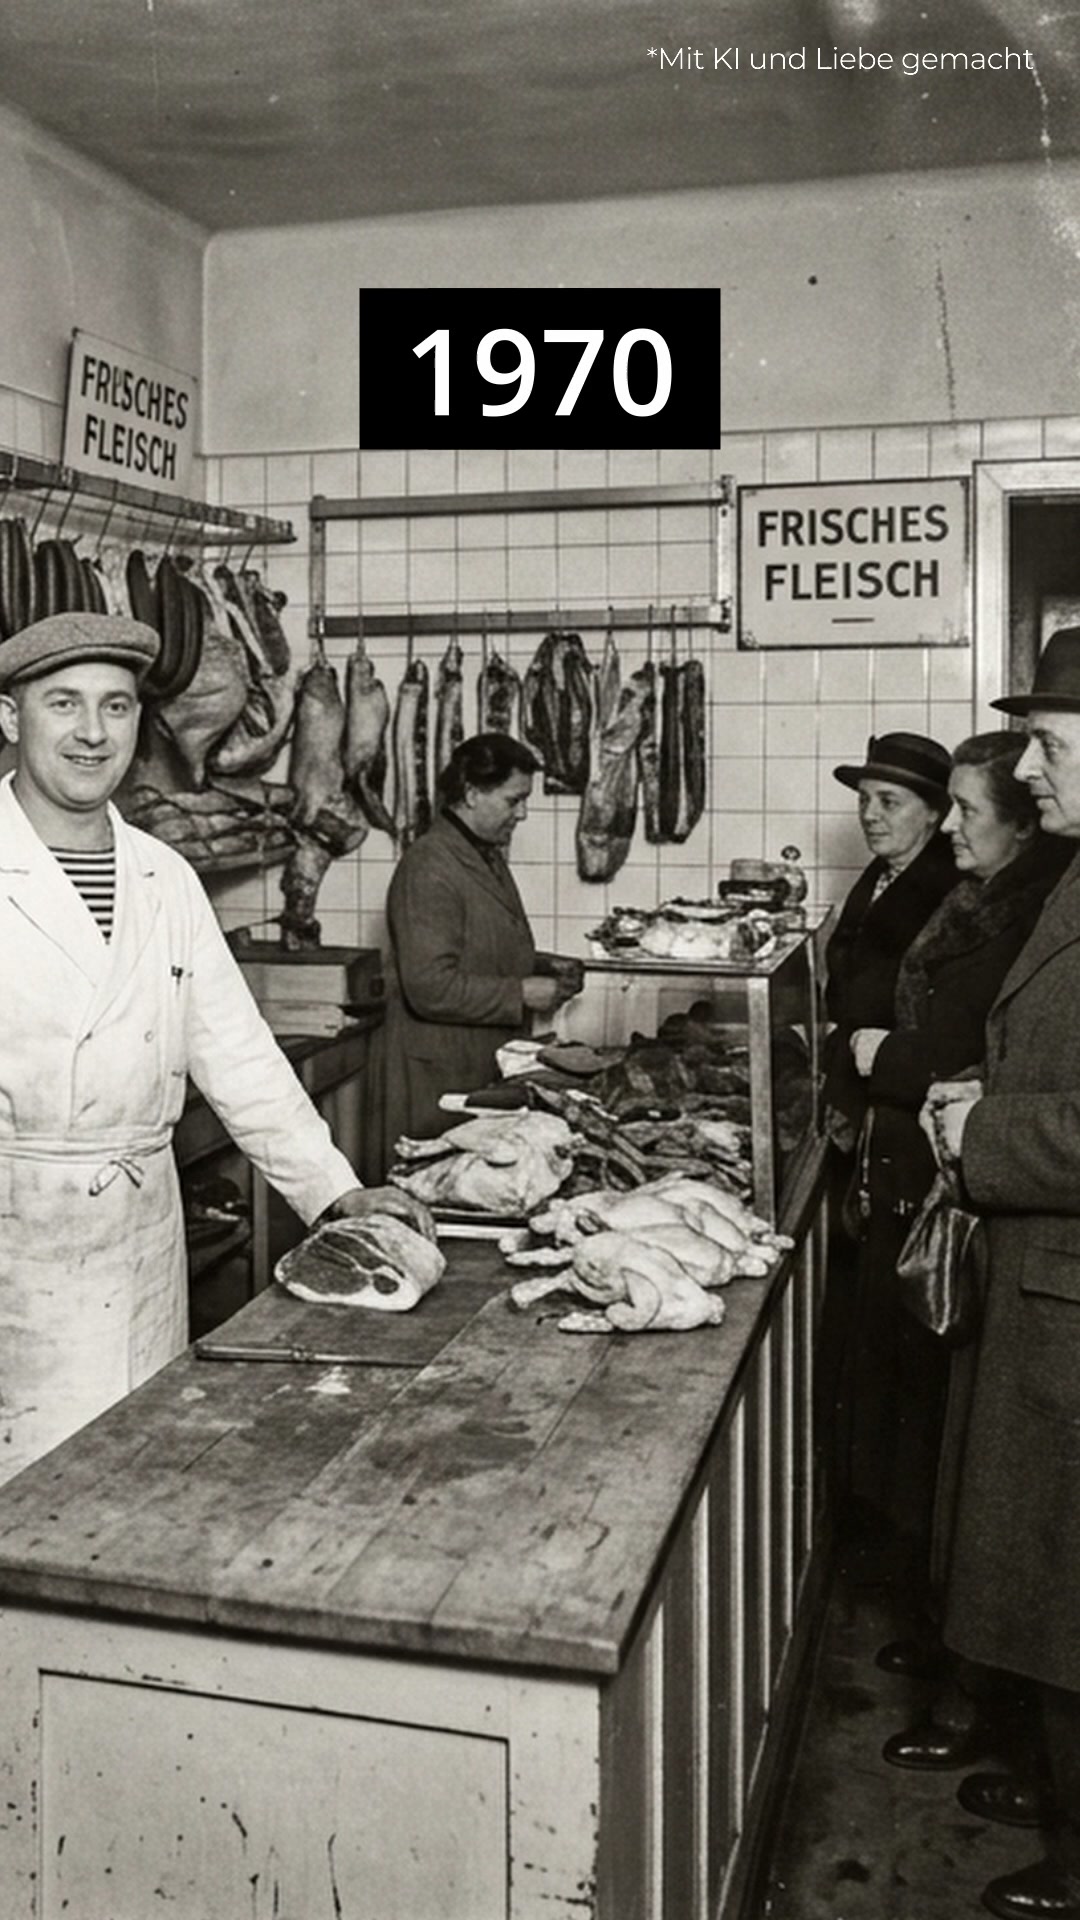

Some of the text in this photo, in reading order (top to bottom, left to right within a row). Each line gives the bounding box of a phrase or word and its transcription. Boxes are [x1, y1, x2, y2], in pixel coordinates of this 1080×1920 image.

[83, 413, 177, 481] FLEISCH
[758, 504, 949, 547] FRISCHES
[765, 559, 939, 601] FLEISCH
